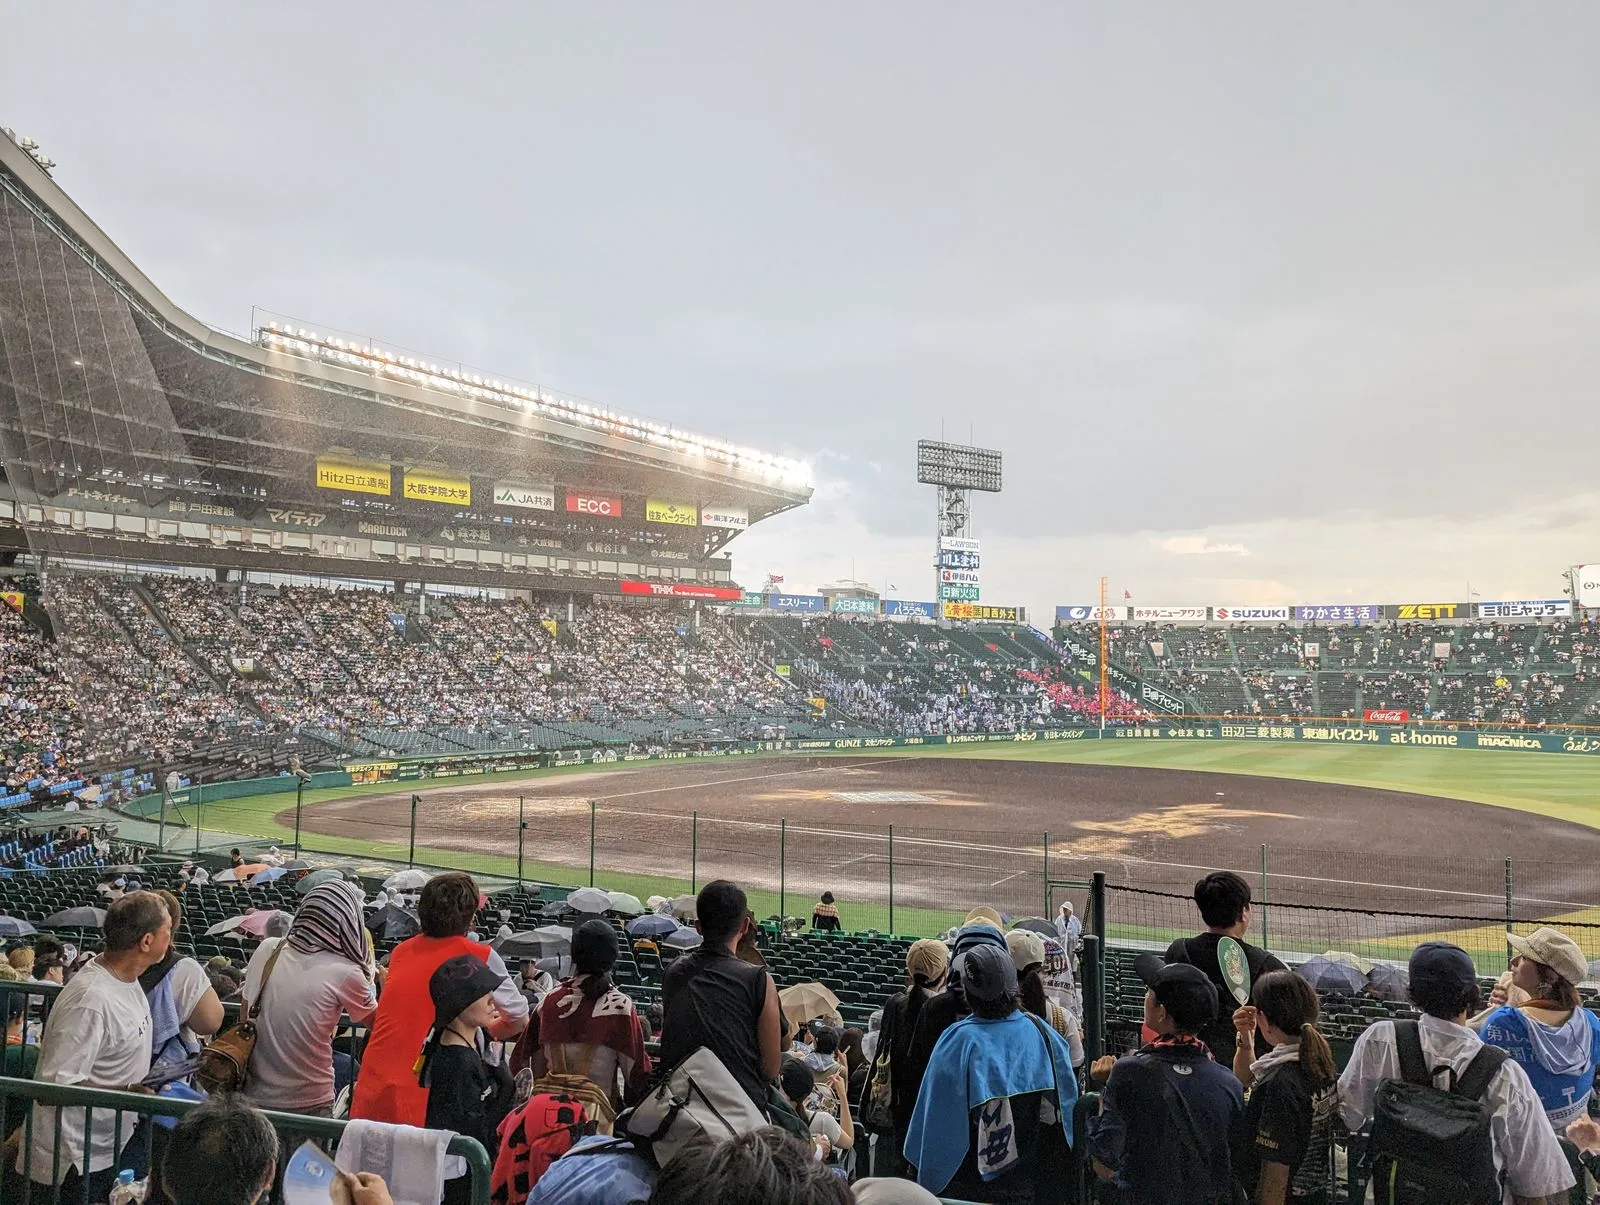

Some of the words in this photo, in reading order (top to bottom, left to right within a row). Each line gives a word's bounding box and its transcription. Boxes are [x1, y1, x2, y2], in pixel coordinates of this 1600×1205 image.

[319, 470, 389, 490] Hitz日立造船
[407, 482, 468, 499] 大阪学院大学
[518, 494, 552, 507] JA共済
[577, 498, 611, 515] ECC
[189, 502, 235, 517] 戸田建設
[266, 507, 326, 527] マイティア
[648, 510, 696, 524] 住友ベークライト
[713, 514, 747, 525] 東洋アルミ
[359, 520, 408, 537] HARDLOCK
[949, 540, 979, 549] LAWSON
[942, 554, 979, 568] 川上塗料
[952, 572, 978, 582] 伊藤ハム
[650, 584, 674, 595] THK
[942, 587, 978, 599] 日新火災
[778, 598, 815, 609] エスリード
[835, 599, 875, 612] 大日本塗料
[902, 606, 928, 616] ろうきん
[952, 604, 973, 617] 黄桜
[982, 607, 1015, 619] 関西外大
[1093, 606, 1116, 619] 白鶴
[1135, 608, 1205, 619] ホテルニューアワジ
[1232, 609, 1287, 618] SUZUKI
[1302, 607, 1371, 620] わかさ生活
[1397, 604, 1457, 619] ZETT
[1484, 604, 1565, 617] 三和シャッター
[1063, 638, 1097, 666] 大同生命
[1107, 667, 1137, 689] 住友ファーマ
[1144, 687, 1184, 713] 日興アセット
[1221, 726, 1295, 739] 田辺三菱製薬
[1302, 728, 1379, 742] 東進ハイスクール
[834, 739, 863, 748] GUNZE
